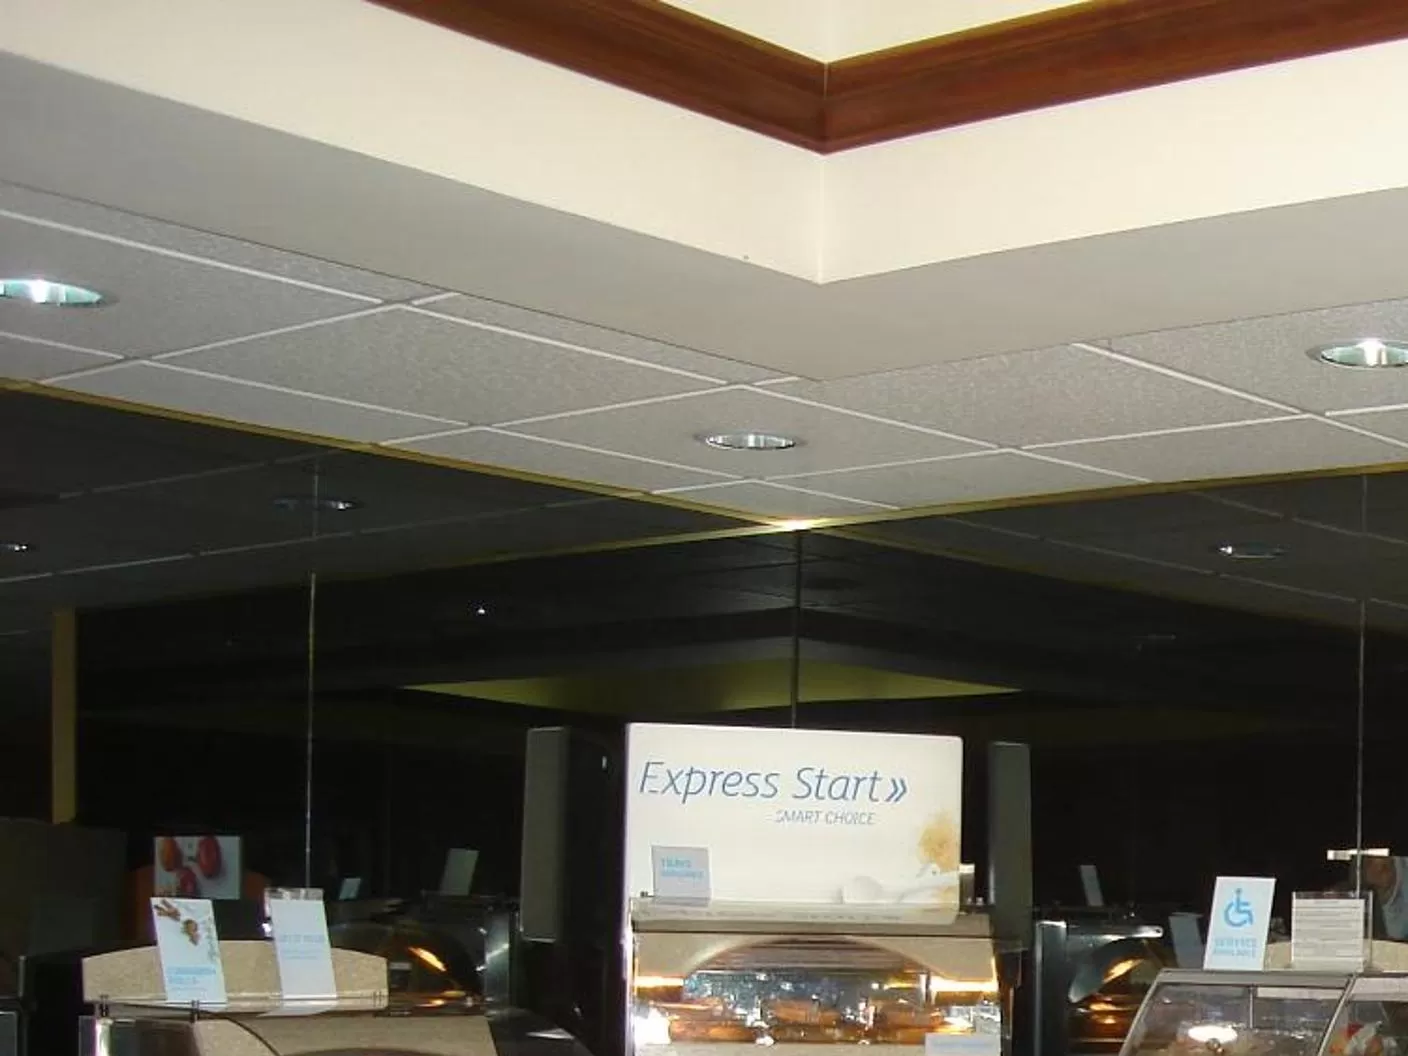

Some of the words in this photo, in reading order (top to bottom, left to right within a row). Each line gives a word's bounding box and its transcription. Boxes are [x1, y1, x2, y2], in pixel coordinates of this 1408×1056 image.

[640, 761, 779, 804] Express
[792, 767, 884, 802] Start
[825, 811, 876, 825] CHOICE
